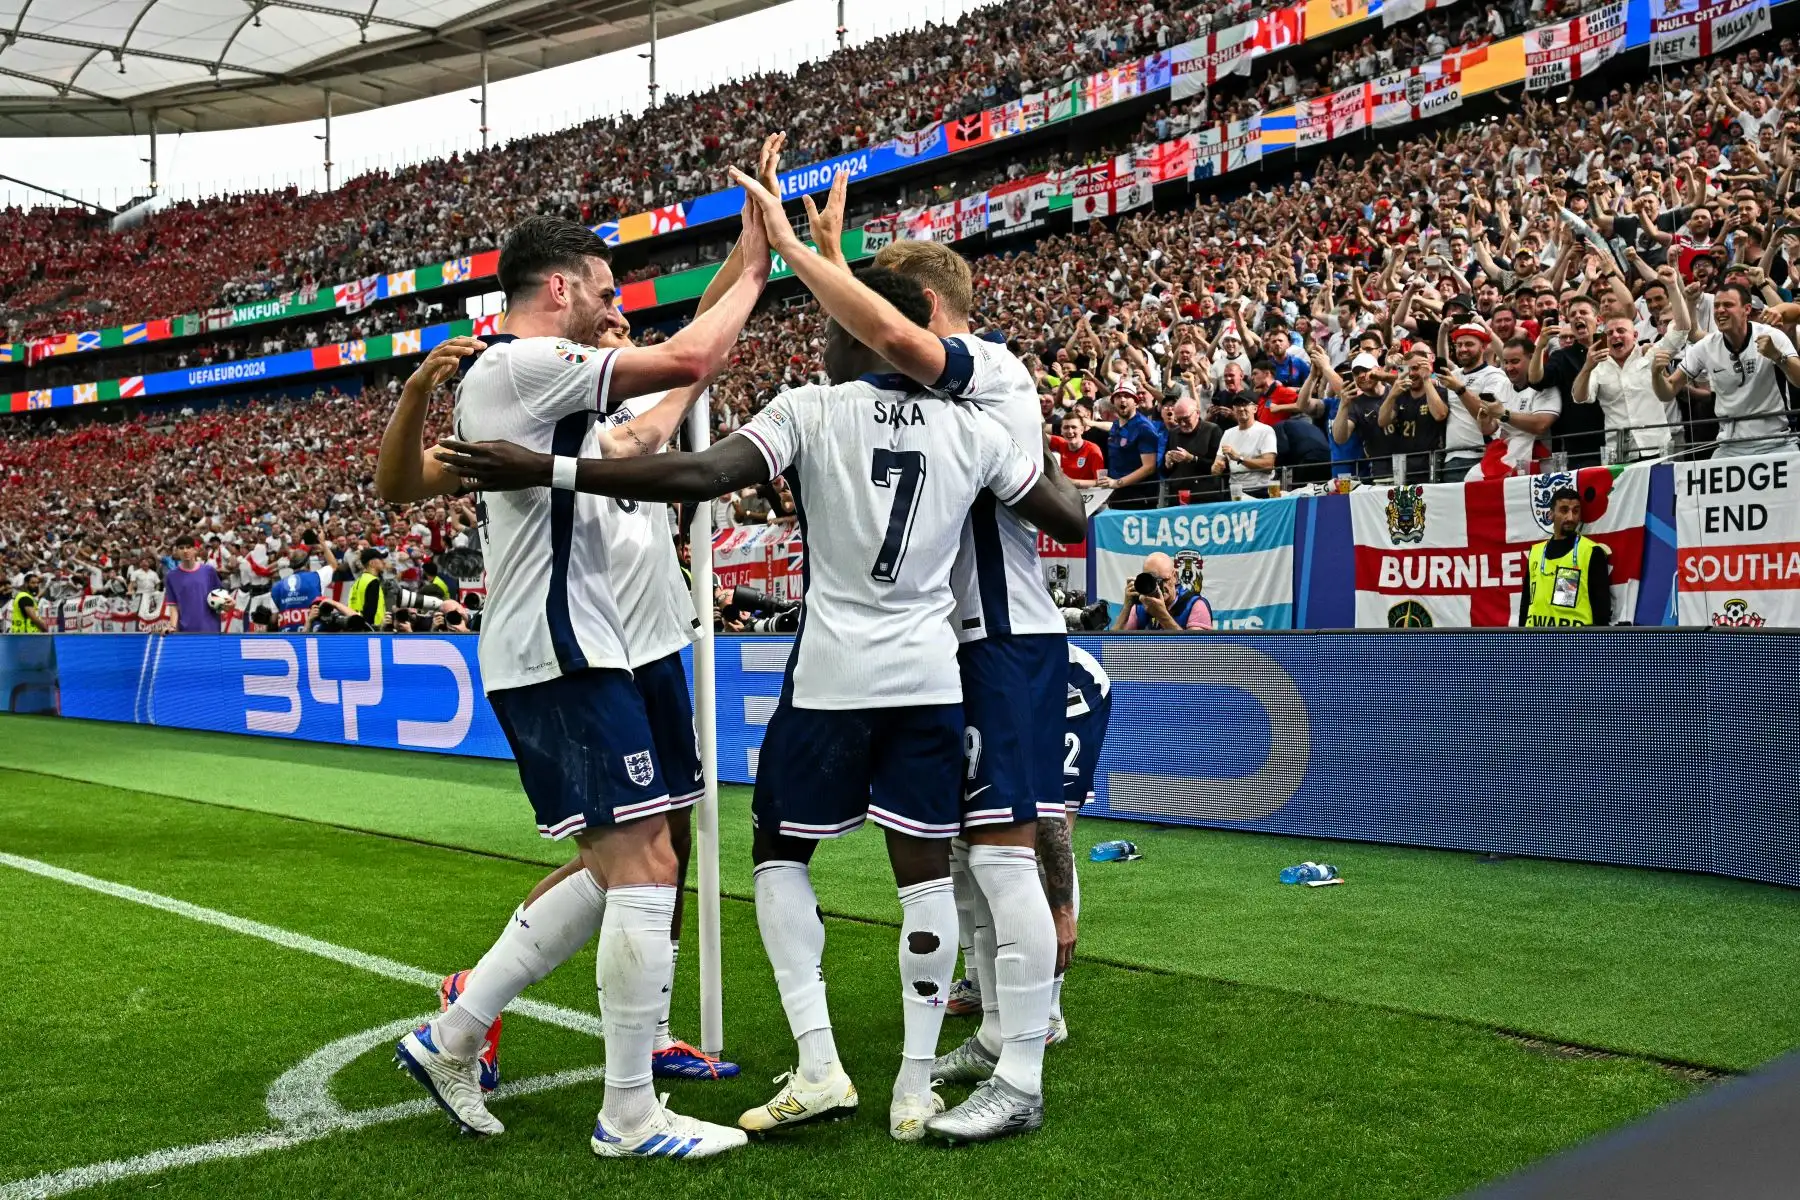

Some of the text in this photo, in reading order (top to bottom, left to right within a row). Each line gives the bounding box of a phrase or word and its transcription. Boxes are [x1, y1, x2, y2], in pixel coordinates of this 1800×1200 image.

[1658, 17, 1689, 32] HULL
[1694, 5, 1725, 23] CITY
[1177, 42, 1249, 74] HARTSHILL
[1424, 91, 1458, 110] VICKO
[232, 303, 287, 323] ANKFURT
[873, 400, 926, 429] SAKA
[1403, 420, 1416, 437] 21
[1687, 461, 1788, 496] HEDGE
[871, 448, 926, 583] 7
[1122, 509, 1258, 547] GLASGOW
[1705, 504, 1768, 533] END
[1684, 552, 1800, 583] SOUTHA
[278, 609, 311, 628] PHOT
[240, 637, 474, 749] BYD
[963, 725, 982, 780] 9
[1063, 732, 1081, 777] 2
